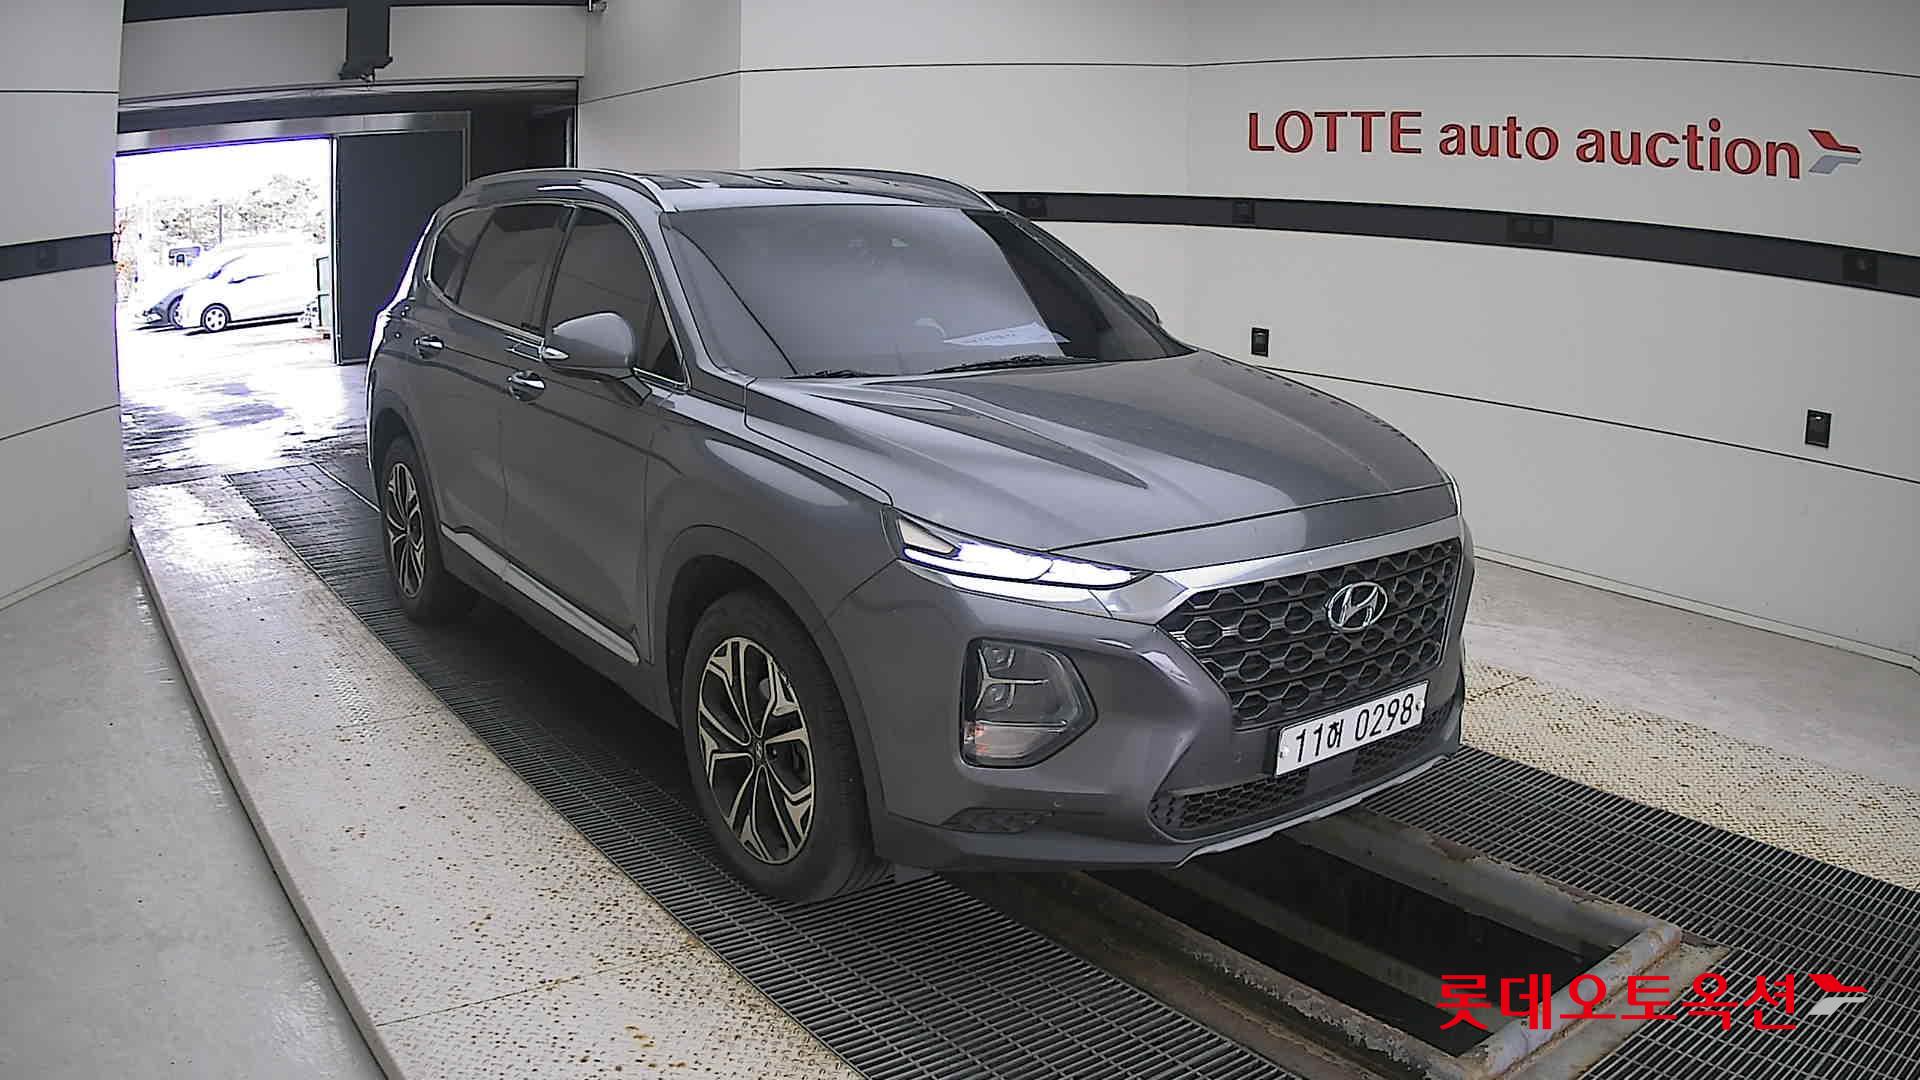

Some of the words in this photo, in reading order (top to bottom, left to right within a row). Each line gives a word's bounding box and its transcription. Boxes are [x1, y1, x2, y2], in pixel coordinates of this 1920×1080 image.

[1248, 111, 1423, 154] LOTTE
[1438, 115, 1560, 160] auto
[1576, 118, 1801, 179] auction
[1296, 718, 1345, 763] 11허
[1354, 692, 1415, 742] 0298
